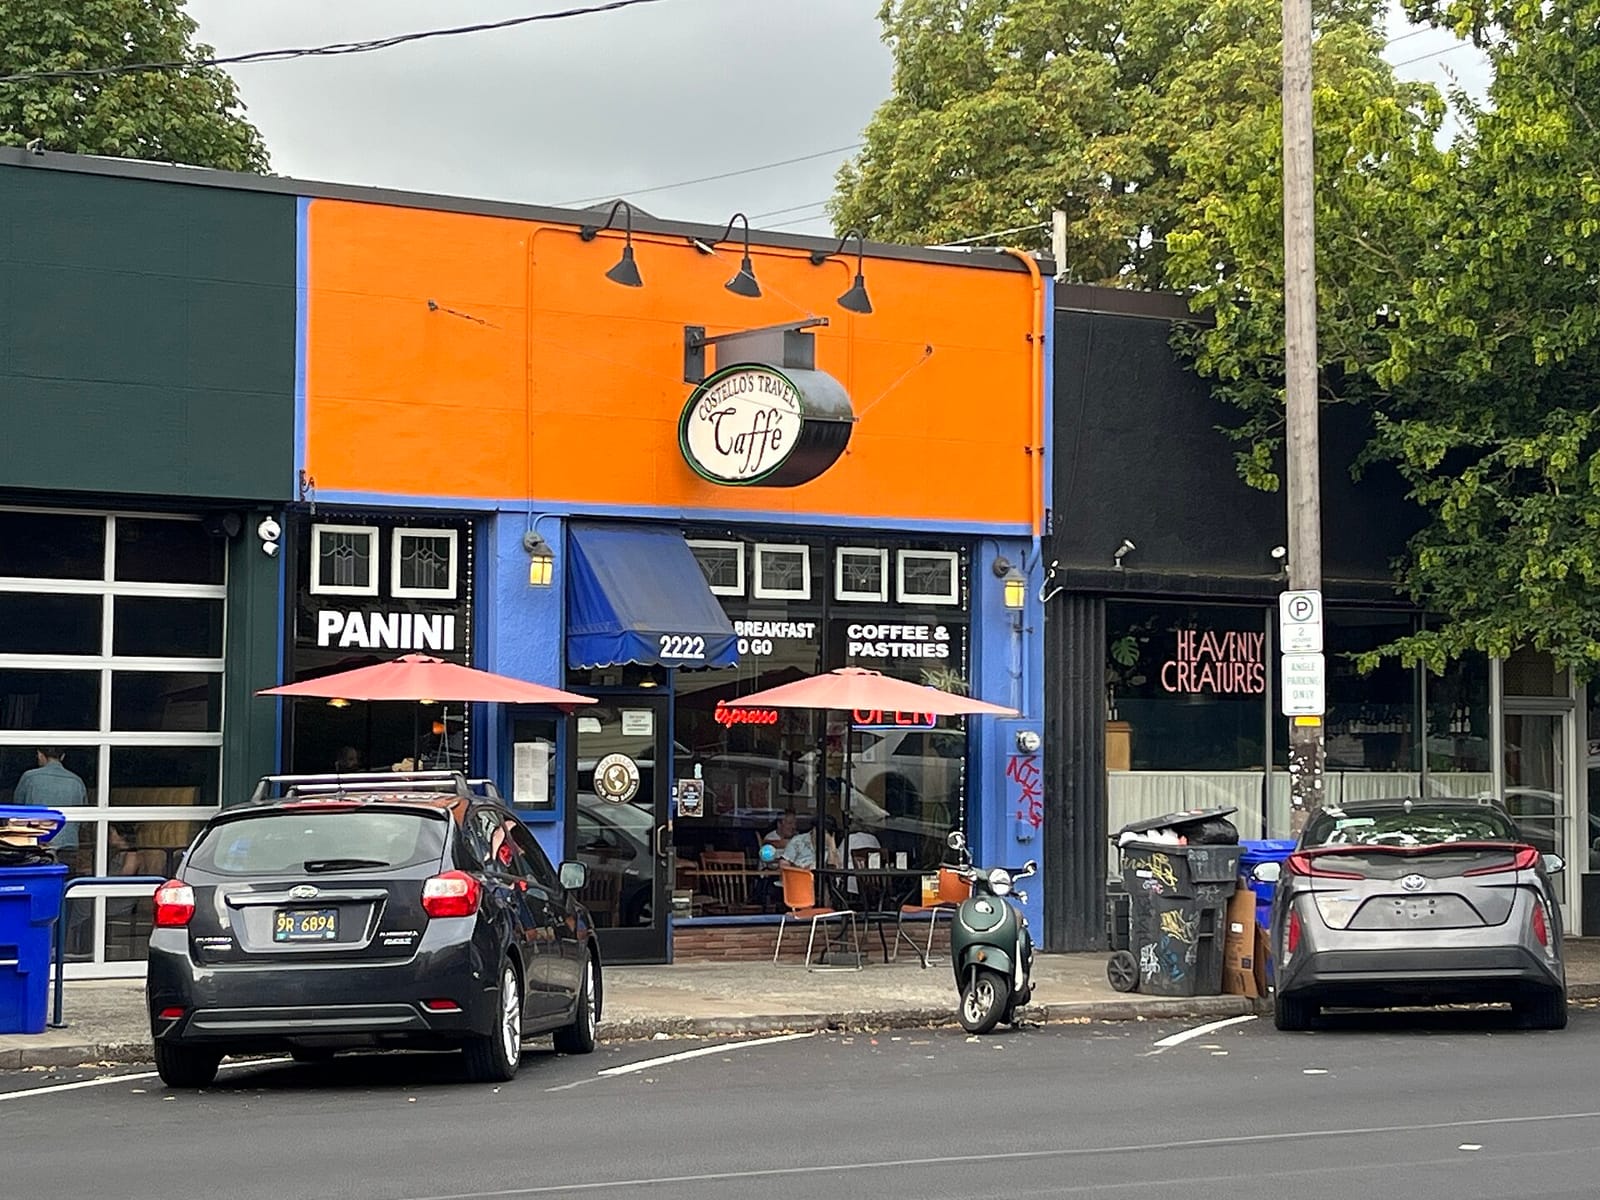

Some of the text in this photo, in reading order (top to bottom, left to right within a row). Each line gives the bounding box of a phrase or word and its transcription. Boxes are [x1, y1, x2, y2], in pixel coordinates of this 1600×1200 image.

[699, 373, 796, 421] COSTELLO'S TRAVEL
[1296, 601, 1308, 617] P
[317, 610, 455, 650] PANINI
[734, 621, 816, 638] BREAKFAST
[847, 624, 951, 641] COFFEE &
[659, 635, 706, 659] 2222
[736, 638, 773, 656] O GO
[848, 641, 950, 658] PASTRIES
[1177, 630, 1265, 662] HEAVENLY
[1291, 662, 1316, 672] ANGLE
[1161, 661, 1265, 694] CREATURES
[1292, 690, 1315, 700] ONLY
[853, 708, 931, 724] OEN
[301, 915, 335, 932] 6894
